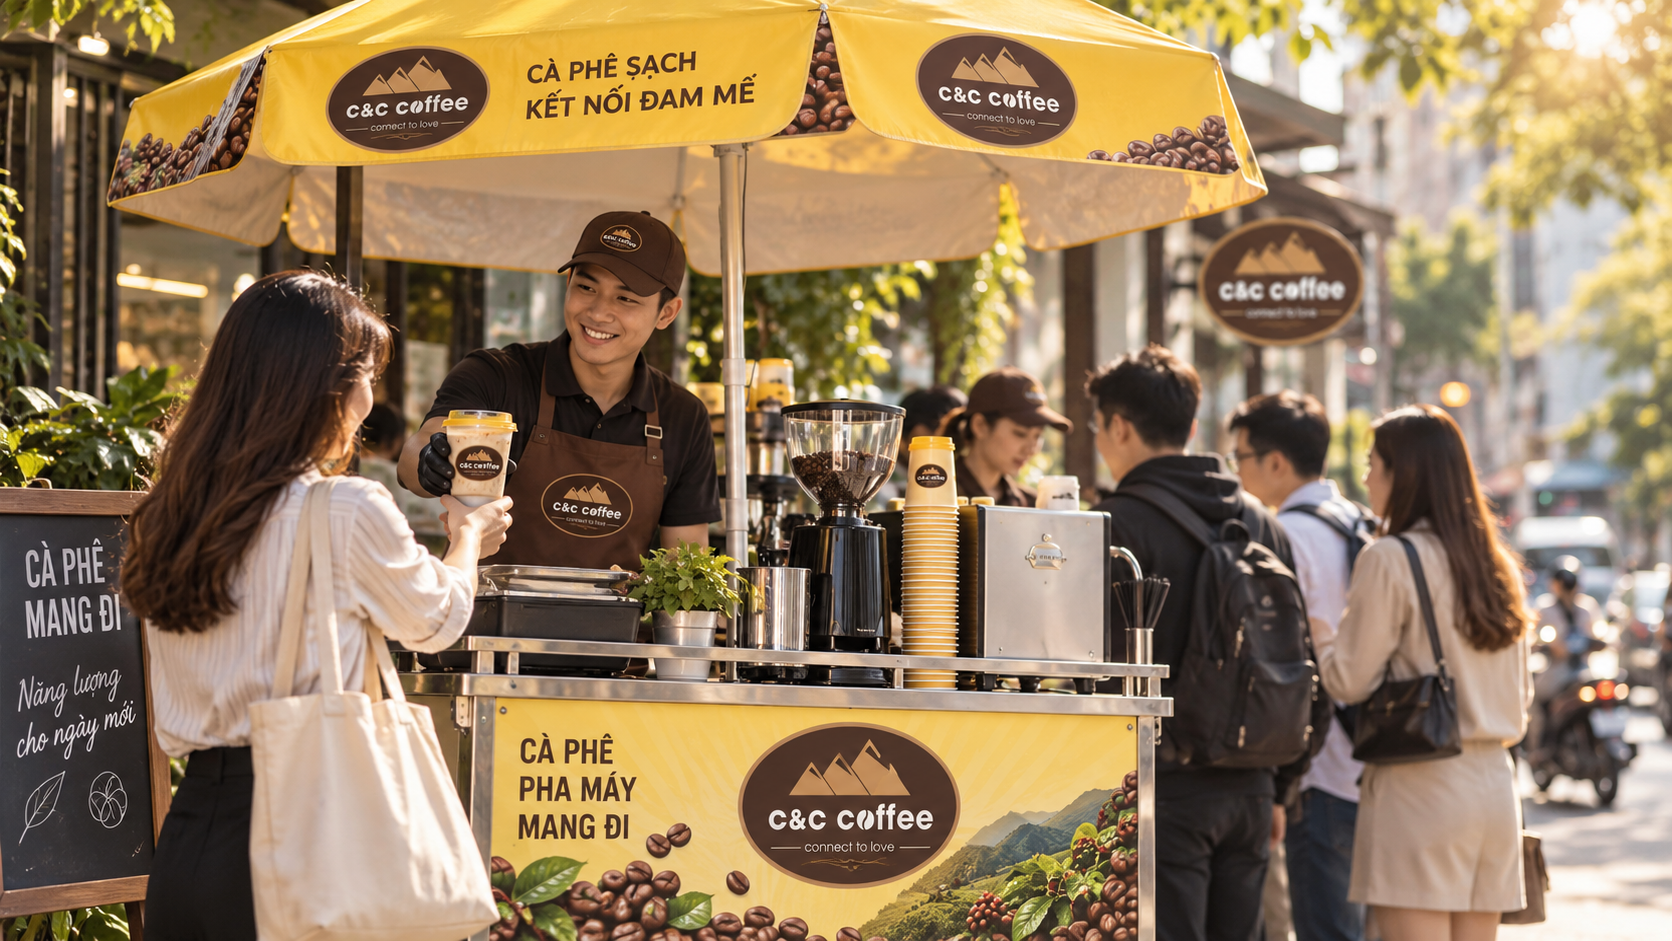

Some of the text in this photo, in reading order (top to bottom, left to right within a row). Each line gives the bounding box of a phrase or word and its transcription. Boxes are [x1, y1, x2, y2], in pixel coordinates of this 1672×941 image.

[527, 58, 561, 84] CÀ
[569, 52, 618, 81] PHÊ
[346, 94, 469, 119] c&c coffee
[526, 88, 576, 120] KẾT
[583, 84, 631, 116] NỐI
[639, 86, 703, 111] ĐAM
[938, 86, 1060, 113] c&c coffee
[408, 121, 418, 129] to
[419, 120, 439, 129] love
[966, 112, 1036, 127] connect to love
[1218, 276, 1346, 301] c&c coffee
[552, 502, 622, 520] c&c coffee
[25, 538, 105, 588] CÀ PHÊ
[25, 593, 122, 639] MANG ĐI
[17, 664, 122, 718] Năng lượng
[16, 700, 137, 760] cho ngày mới
[520, 732, 613, 764] CÀ PHÊ
[519, 771, 637, 802] PHA MÁY
[518, 813, 629, 840] MANG ĐI
[768, 803, 934, 831] c&c coffee
[804, 840, 895, 853] connect to love
